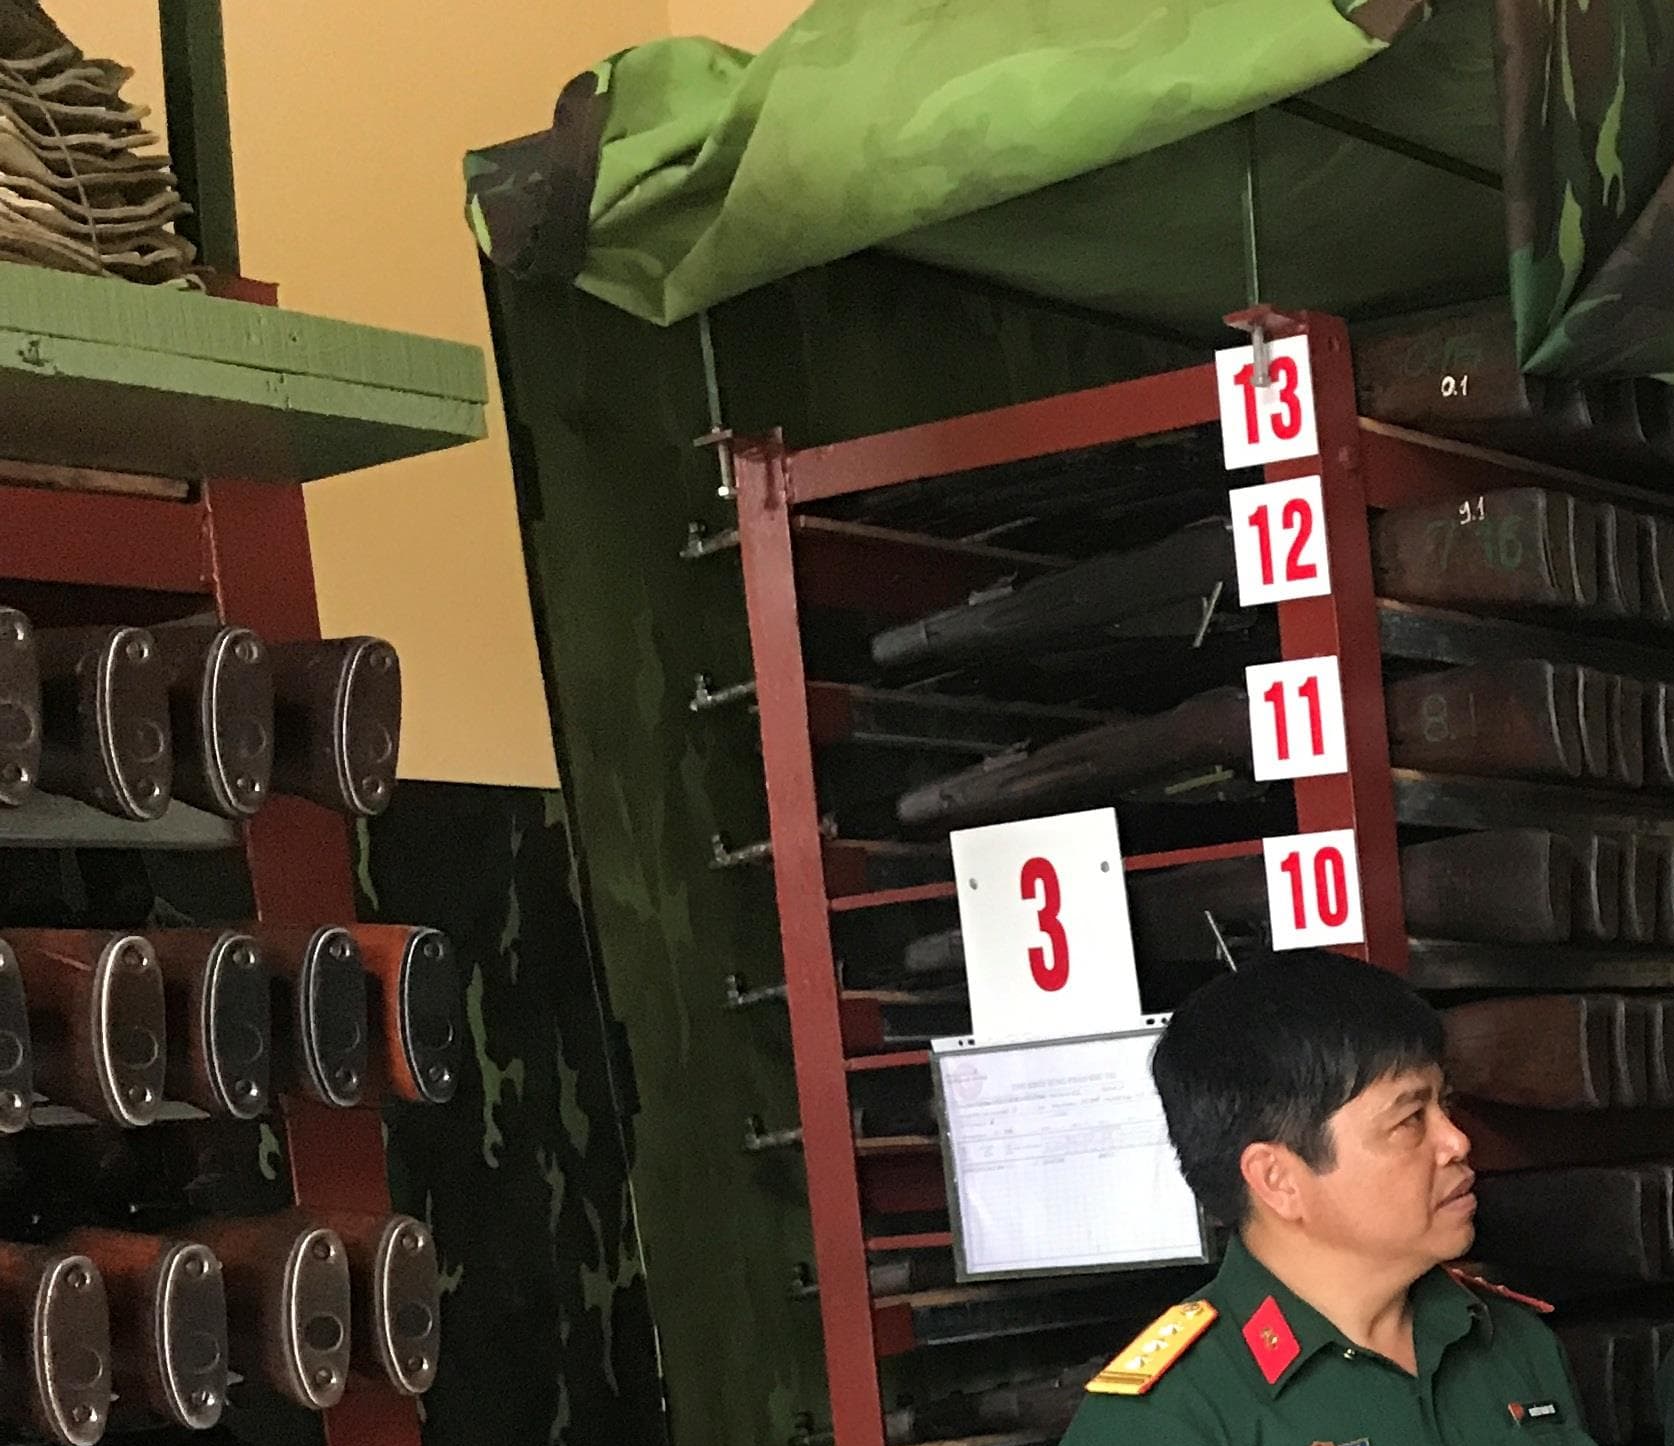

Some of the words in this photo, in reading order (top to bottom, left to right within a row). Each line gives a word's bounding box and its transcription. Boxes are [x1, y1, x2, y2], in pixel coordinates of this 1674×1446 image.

[1234, 357, 1302, 444] 13
[1249, 498, 1317, 585] 12
[1264, 677, 1324, 760] 11
[1021, 857, 1069, 991] 3
[1281, 847, 1348, 929] 10
